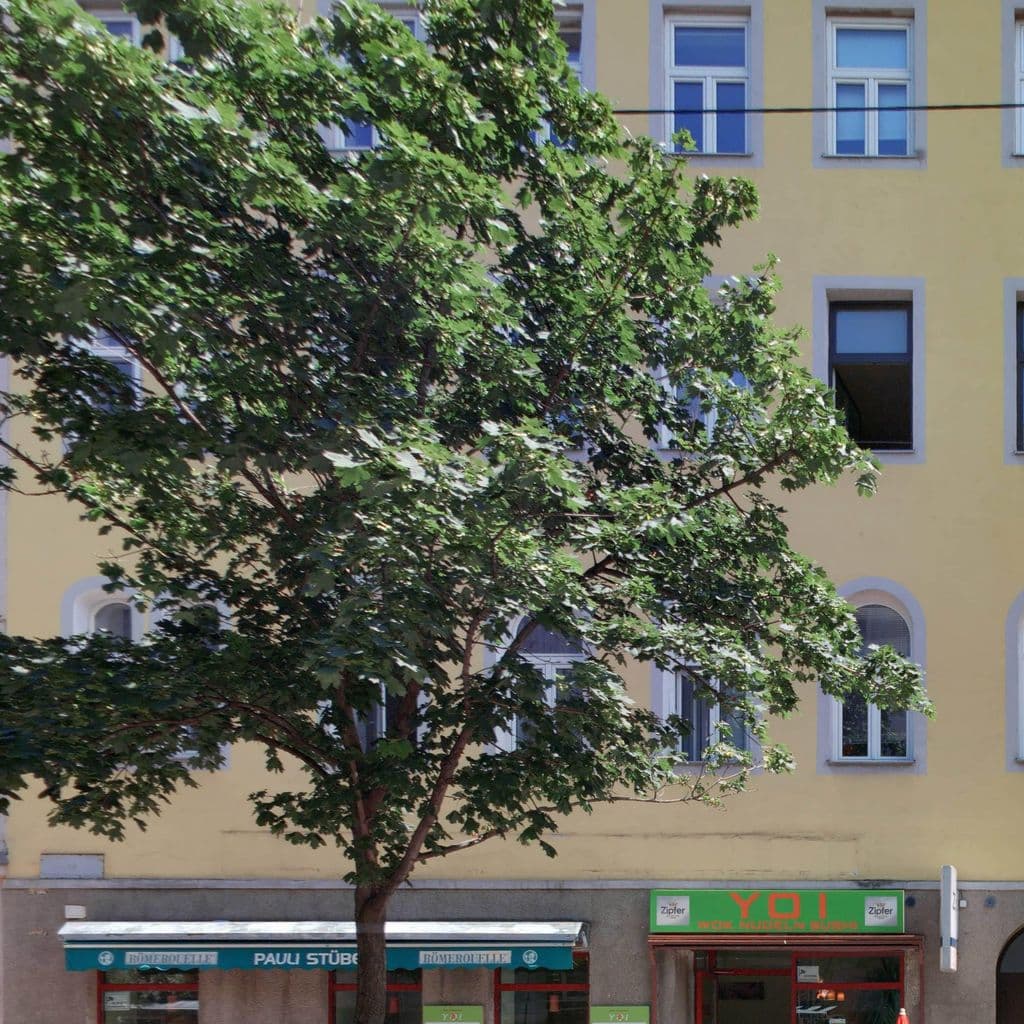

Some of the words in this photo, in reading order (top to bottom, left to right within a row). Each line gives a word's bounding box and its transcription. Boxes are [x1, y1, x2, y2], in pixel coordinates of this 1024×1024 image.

[660, 907, 686, 915] Zipfer
[730, 893, 827, 919] YOI
[868, 907, 894, 915] Zipfer
[253, 952, 300, 966] PAULI
